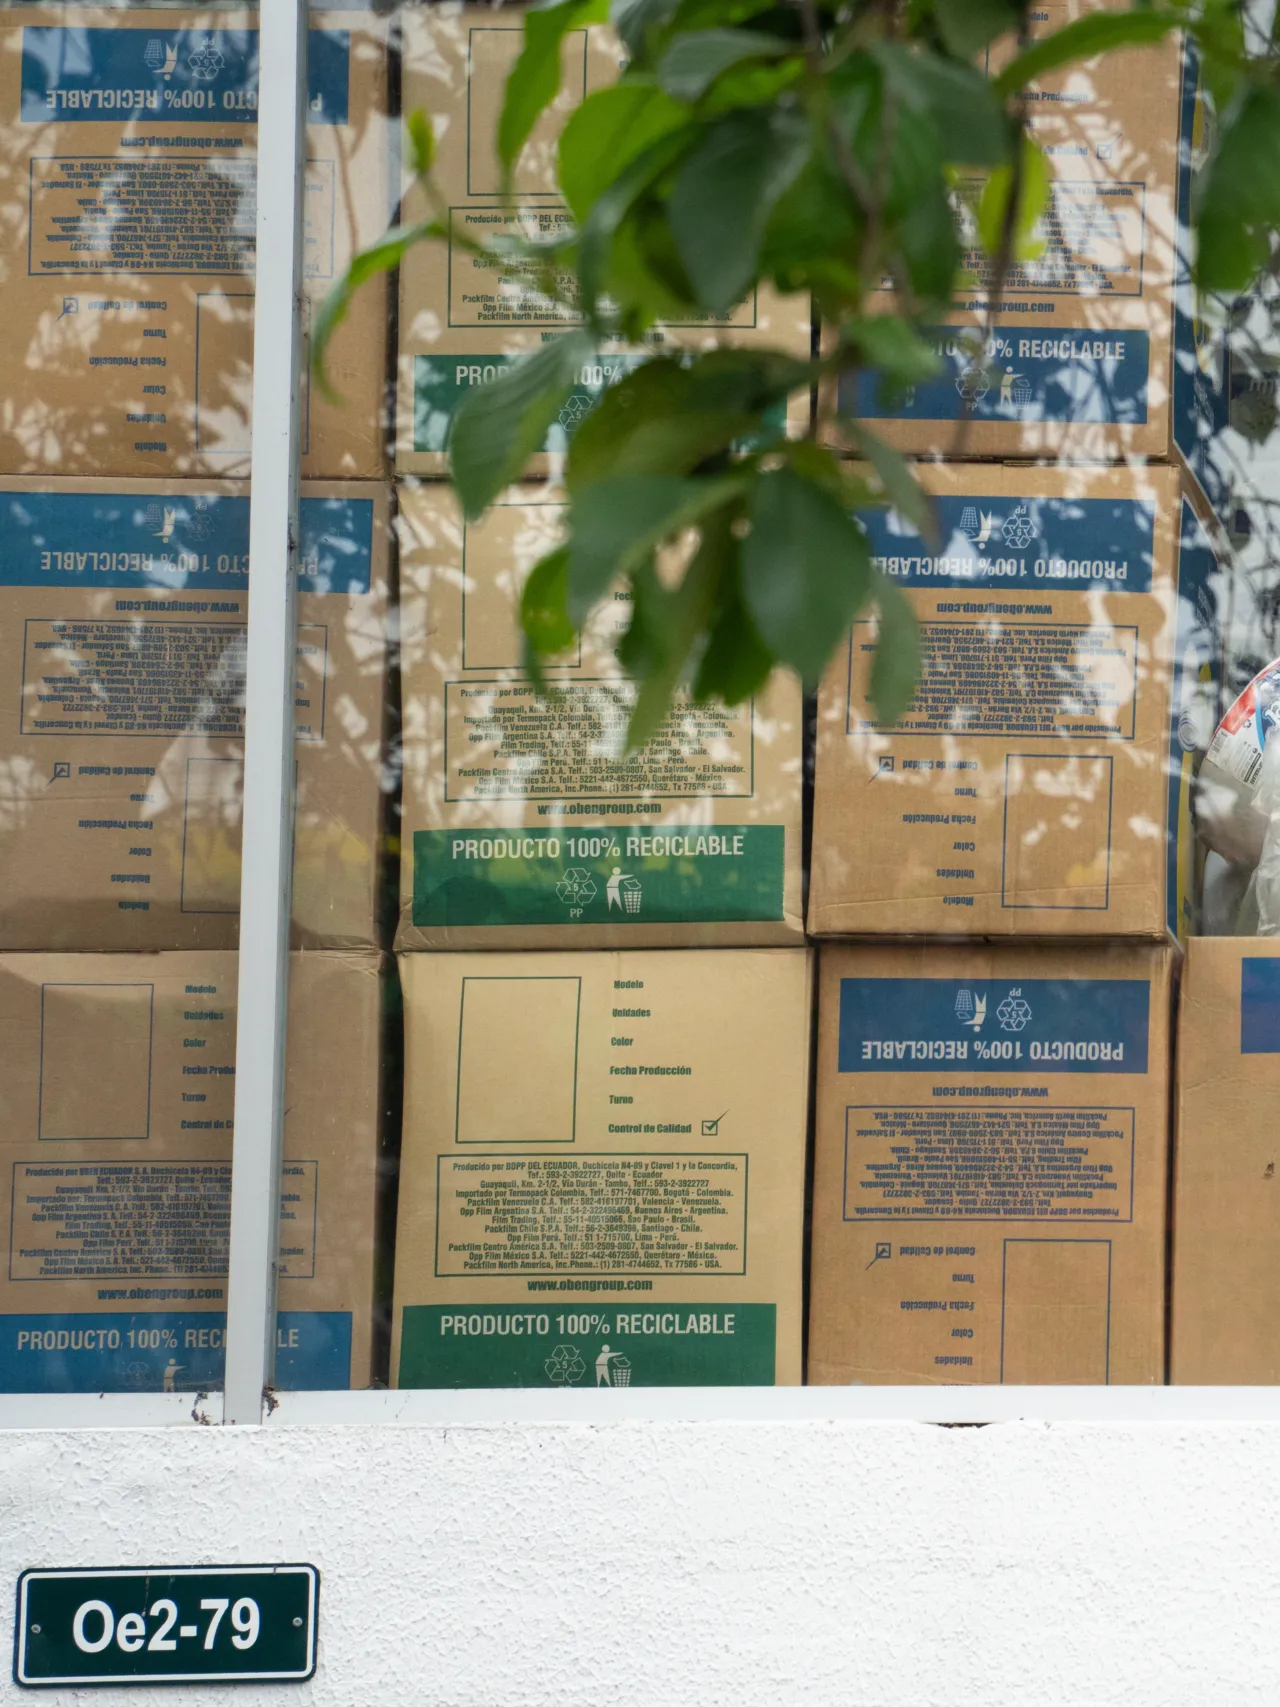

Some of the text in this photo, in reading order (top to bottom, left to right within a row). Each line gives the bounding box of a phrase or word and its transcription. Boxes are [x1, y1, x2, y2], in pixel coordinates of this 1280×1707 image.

[46, 89, 322, 111] PCTO 100% RECICLABLE
[143, 329, 167, 338] Turno
[1019, 340, 1124, 362] RECICLABLE
[143, 385, 166, 395] Color
[126, 414, 166, 424] Unidades
[135, 442, 166, 452] Modelo
[41, 552, 318, 576] PRCTO 100% RECICLABLE
[975, 559, 1027, 576] 100%
[1035, 558, 1127, 579] PRODUCTO
[116, 601, 239, 613] www.obengroup.com
[903, 760, 977, 770] Control Calidad
[955, 788, 977, 797] Turno
[538, 803, 661, 815] www.obengroup.com
[903, 814, 976, 824] Fecha Producción
[453, 834, 743, 859] PRODUCTO 100% RECICLABLE
[953, 842, 975, 851] Color
[129, 848, 151, 856] Color
[111, 874, 150, 883] Unidades
[937, 869, 974, 879] Unidades
[118, 901, 149, 910] Modelo
[943, 897, 973, 906] Modelo
[570, 908, 583, 917] PP
[185, 985, 216, 993] Modelo
[614, 980, 643, 989] Modelo
[184, 1011, 224, 1020] Unidades
[612, 1008, 650, 1017] Unidades
[184, 1039, 206, 1047] Color
[611, 1037, 633, 1046] Color
[862, 1041, 1123, 1060] PRODUCTO 100% RECICLABLE
[183, 1066, 207, 1074] Fecha
[610, 1066, 691, 1075] Fecha Producción
[932, 1086, 1048, 1097] www.obengroup.com
[182, 1093, 206, 1102] Turno
[609, 1095, 633, 1104] Turno
[181, 1120, 212, 1129] Control
[608, 1124, 691, 1133] Control de Calidad
[453, 1163, 490, 1171] Producido
[544, 1162, 580, 1170] ECUADOR,
[698, 1162, 738, 1170] Concordia,
[456, 1190, 492, 1198] Importado
[551, 1189, 587, 1197] Colombia,
[697, 1188, 733, 1196] Colombia.
[485, 1225, 517, 1233] Packfilm
[641, 1224, 673, 1233] Santiago
[681, 1224, 702, 1232] Chile.
[510, 1241, 540, 1250] América
[656, 1242, 688, 1250] Salvador
[704, 1242, 738, 1250] Salvador.
[900, 1247, 975, 1256] Control Calidad
[520, 1261, 553, 1269] America,
[705, 1260, 722, 1268] USA.
[952, 1274, 974, 1283] Turno
[528, 1280, 652, 1291] www.obengroup.com
[98, 1288, 224, 1300] www.obengroup.com
[901, 1301, 974, 1311] Fecha Producción
[441, 1314, 735, 1335] PRODUCTO 100% RECICLABLE
[951, 1329, 973, 1338] Color
[18, 1329, 299, 1350] PRODUCTO 100% RECILE
[935, 1356, 972, 1365] Unidades
[73, 1597, 260, 1653] Oe2-79
